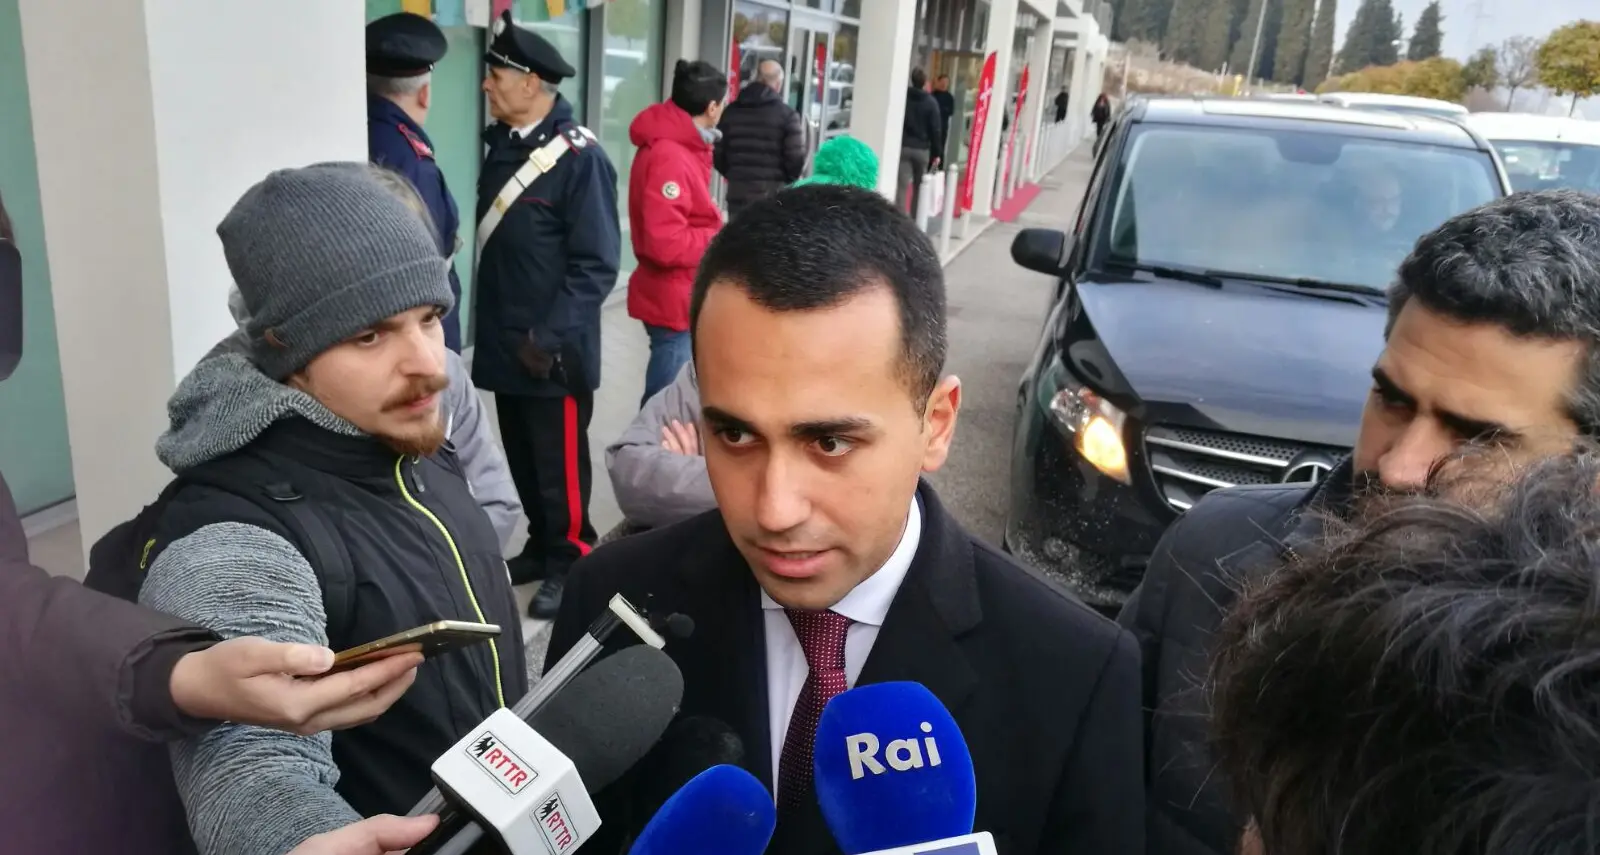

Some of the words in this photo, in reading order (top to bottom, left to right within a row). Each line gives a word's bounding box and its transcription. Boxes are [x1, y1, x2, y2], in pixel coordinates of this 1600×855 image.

[484, 747, 528, 788] RTTR
[845, 721, 942, 780] Rai
[546, 811, 572, 850] RTTR
